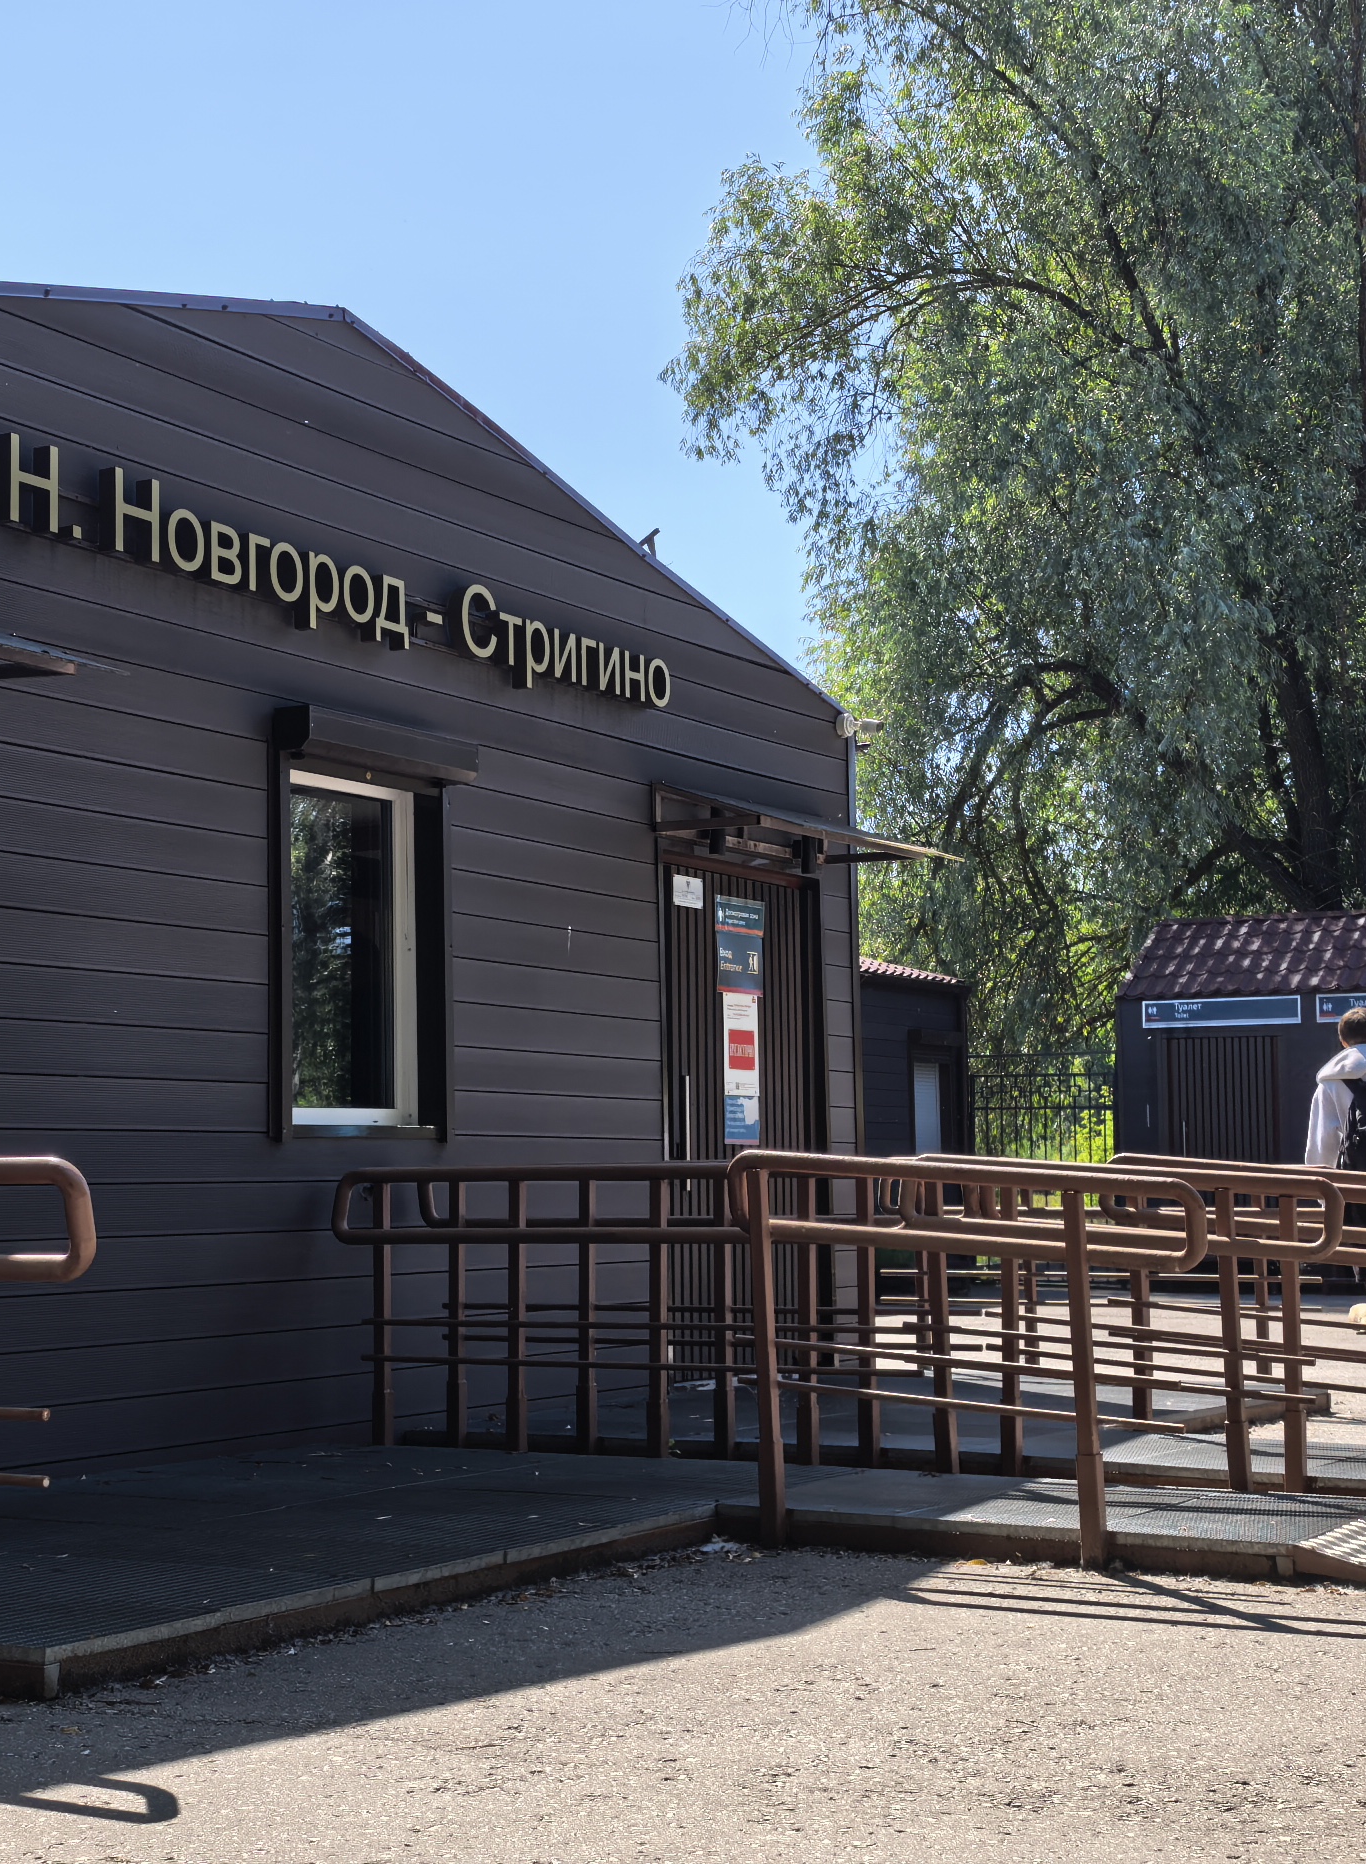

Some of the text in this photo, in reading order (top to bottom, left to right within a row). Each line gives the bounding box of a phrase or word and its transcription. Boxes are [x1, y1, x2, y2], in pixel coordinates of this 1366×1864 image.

[6, 431, 672, 708] Н. Новгород - Стригино
[720, 960, 743, 973] Entrance
[1174, 1002, 1202, 1012] Туалет
